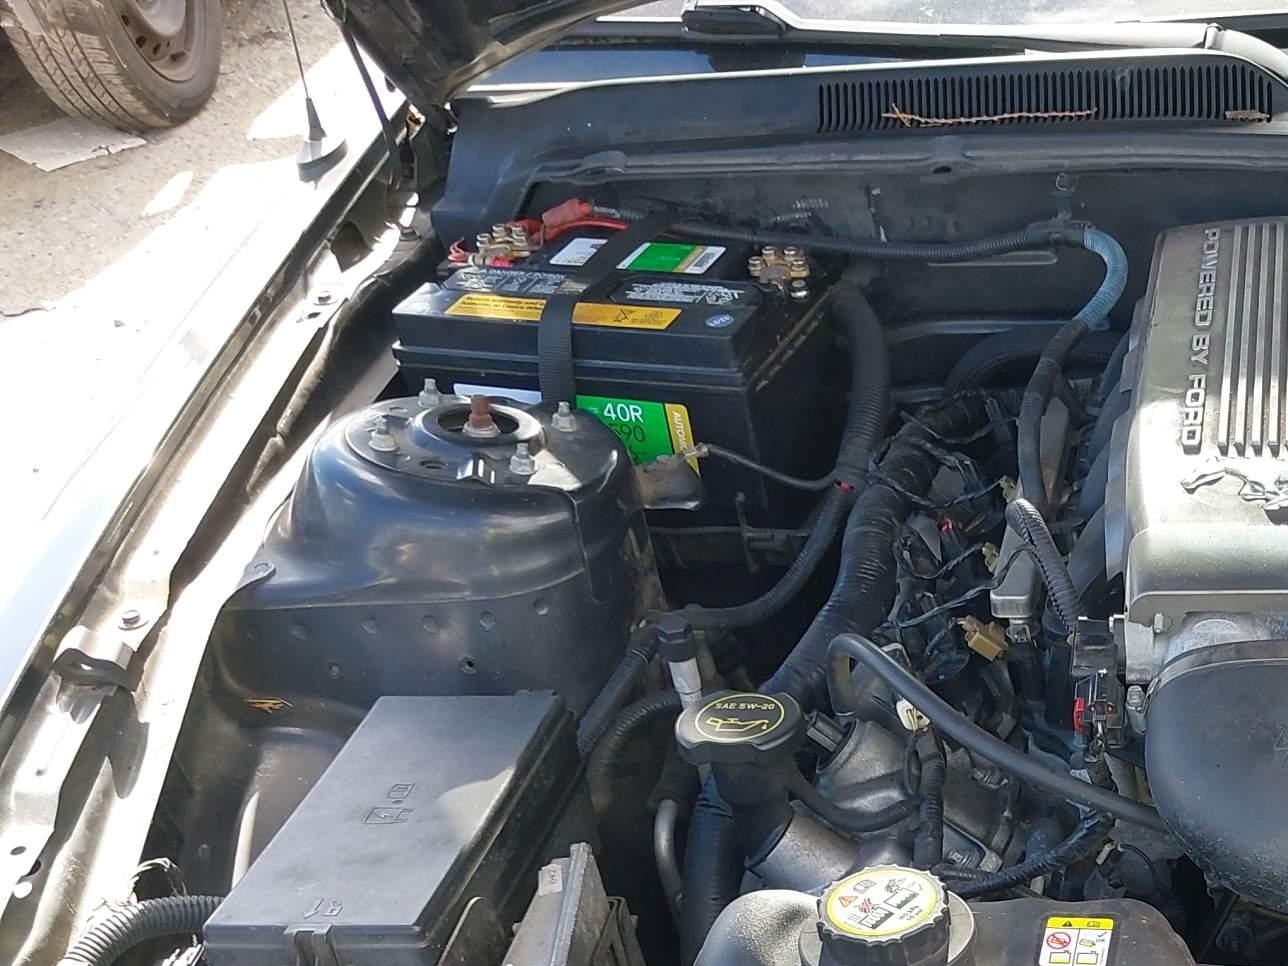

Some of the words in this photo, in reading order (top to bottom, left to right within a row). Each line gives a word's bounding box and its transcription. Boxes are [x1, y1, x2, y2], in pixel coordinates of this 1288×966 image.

[1195, 227, 1221, 327] POWERED
[1190, 333, 1210, 365] BY
[603, 402, 644, 423] 40R
[1182, 373, 1206, 446] FORD
